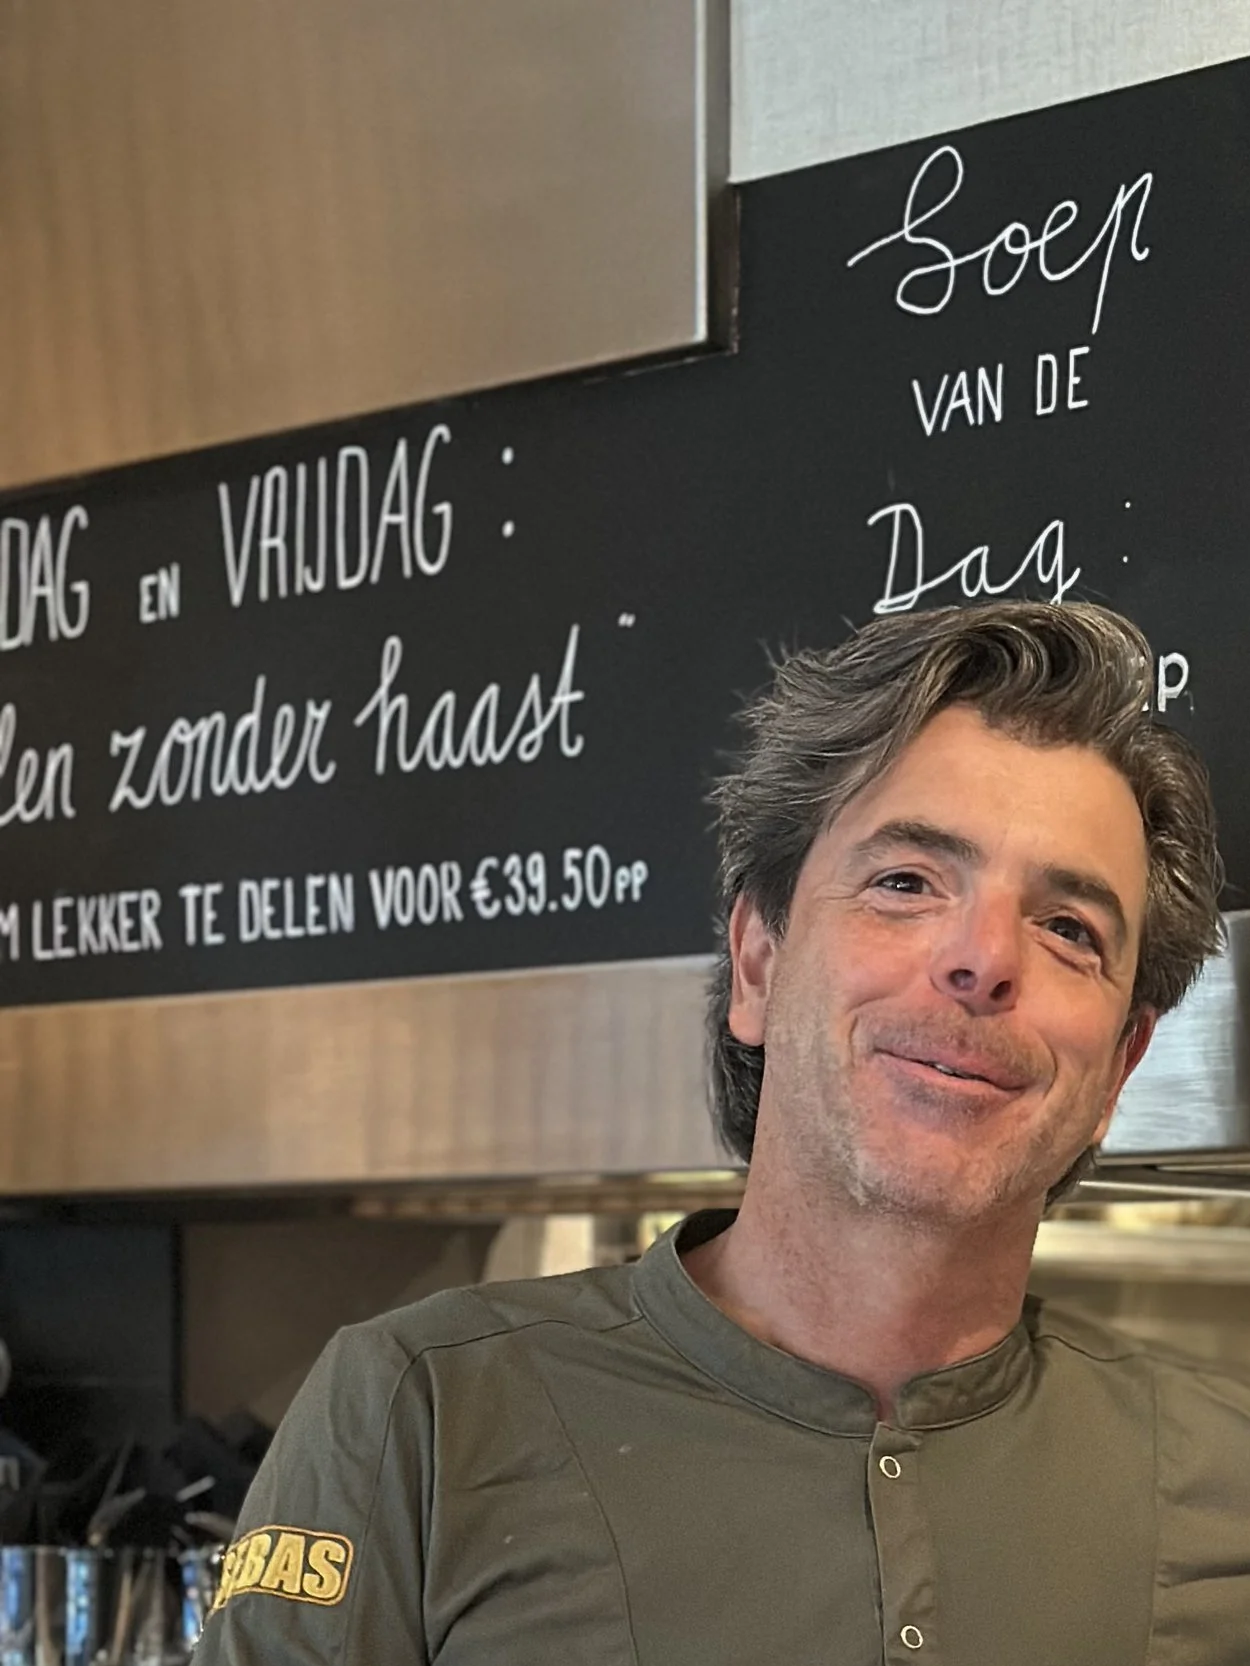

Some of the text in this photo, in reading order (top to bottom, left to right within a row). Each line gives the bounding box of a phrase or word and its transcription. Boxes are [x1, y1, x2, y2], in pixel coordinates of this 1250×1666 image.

[847, 146, 1153, 334] Soep
[912, 346, 1090, 436] VAN DE
[140, 564, 179, 622] EN
[219, 424, 451, 606] VRIJDAG
[868, 504, 1080, 614] Dag
[110, 676, 335, 811] zonder
[355, 625, 584, 774] haast
[33, 890, 162, 959] LEKKER
[180, 883, 224, 945] TE
[239, 874, 354, 942] DELEN
[369, 861, 463, 942] VOOR
